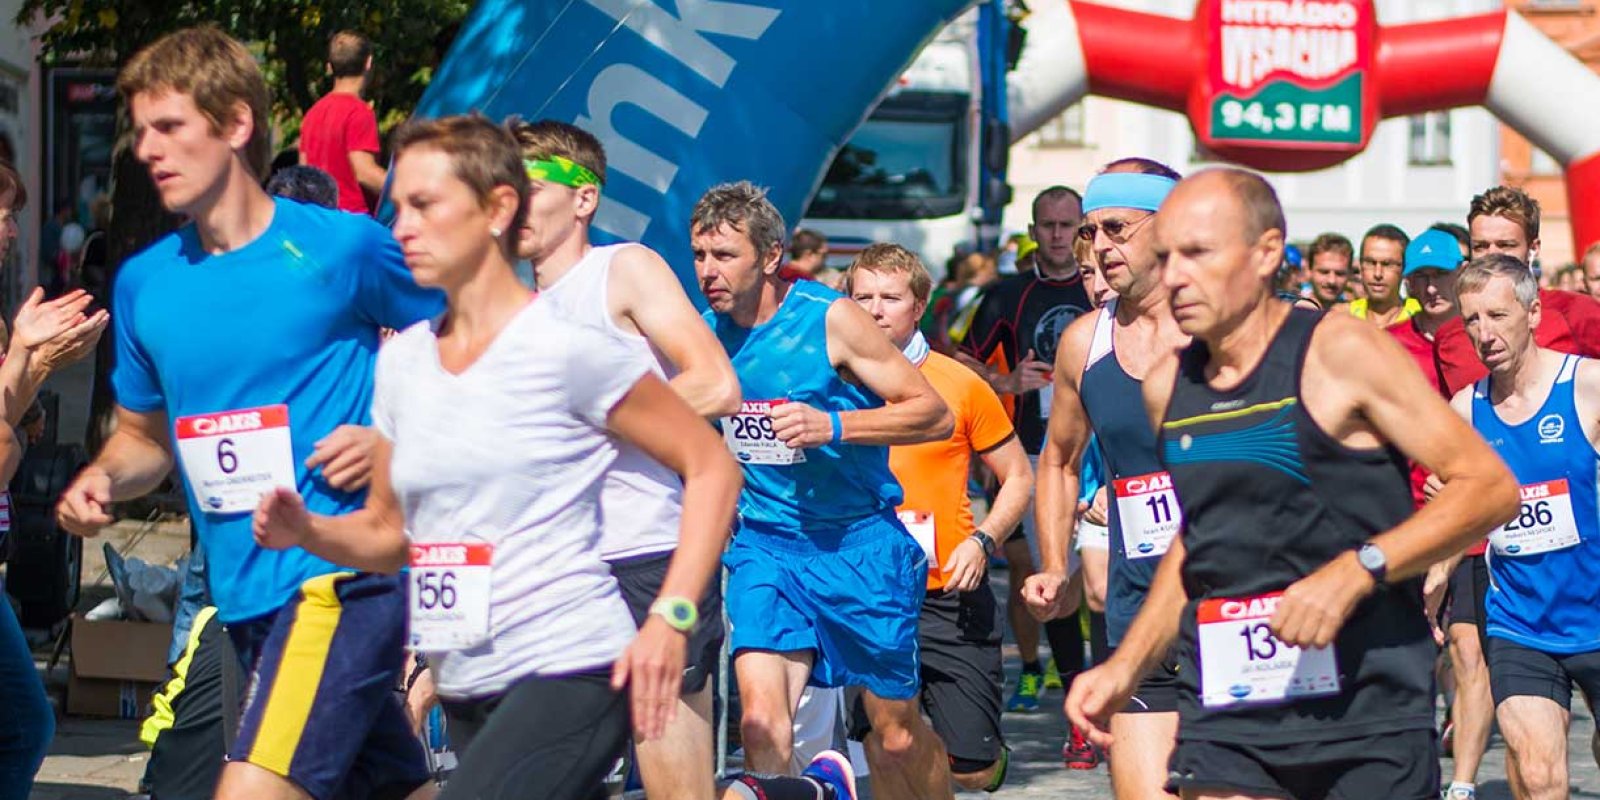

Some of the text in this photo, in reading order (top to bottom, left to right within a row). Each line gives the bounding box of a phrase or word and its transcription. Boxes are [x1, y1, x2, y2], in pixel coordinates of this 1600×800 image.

[1221, 100, 1352, 133] 94,3 FM
[741, 402, 770, 413] AXIS
[219, 411, 261, 432] AXIS
[731, 416, 776, 439] 269
[217, 437, 239, 474] 6
[1149, 475, 1173, 492] AX
[1146, 494, 1171, 524] 11
[427, 546, 467, 564] AXIS
[417, 572, 456, 610] 156
